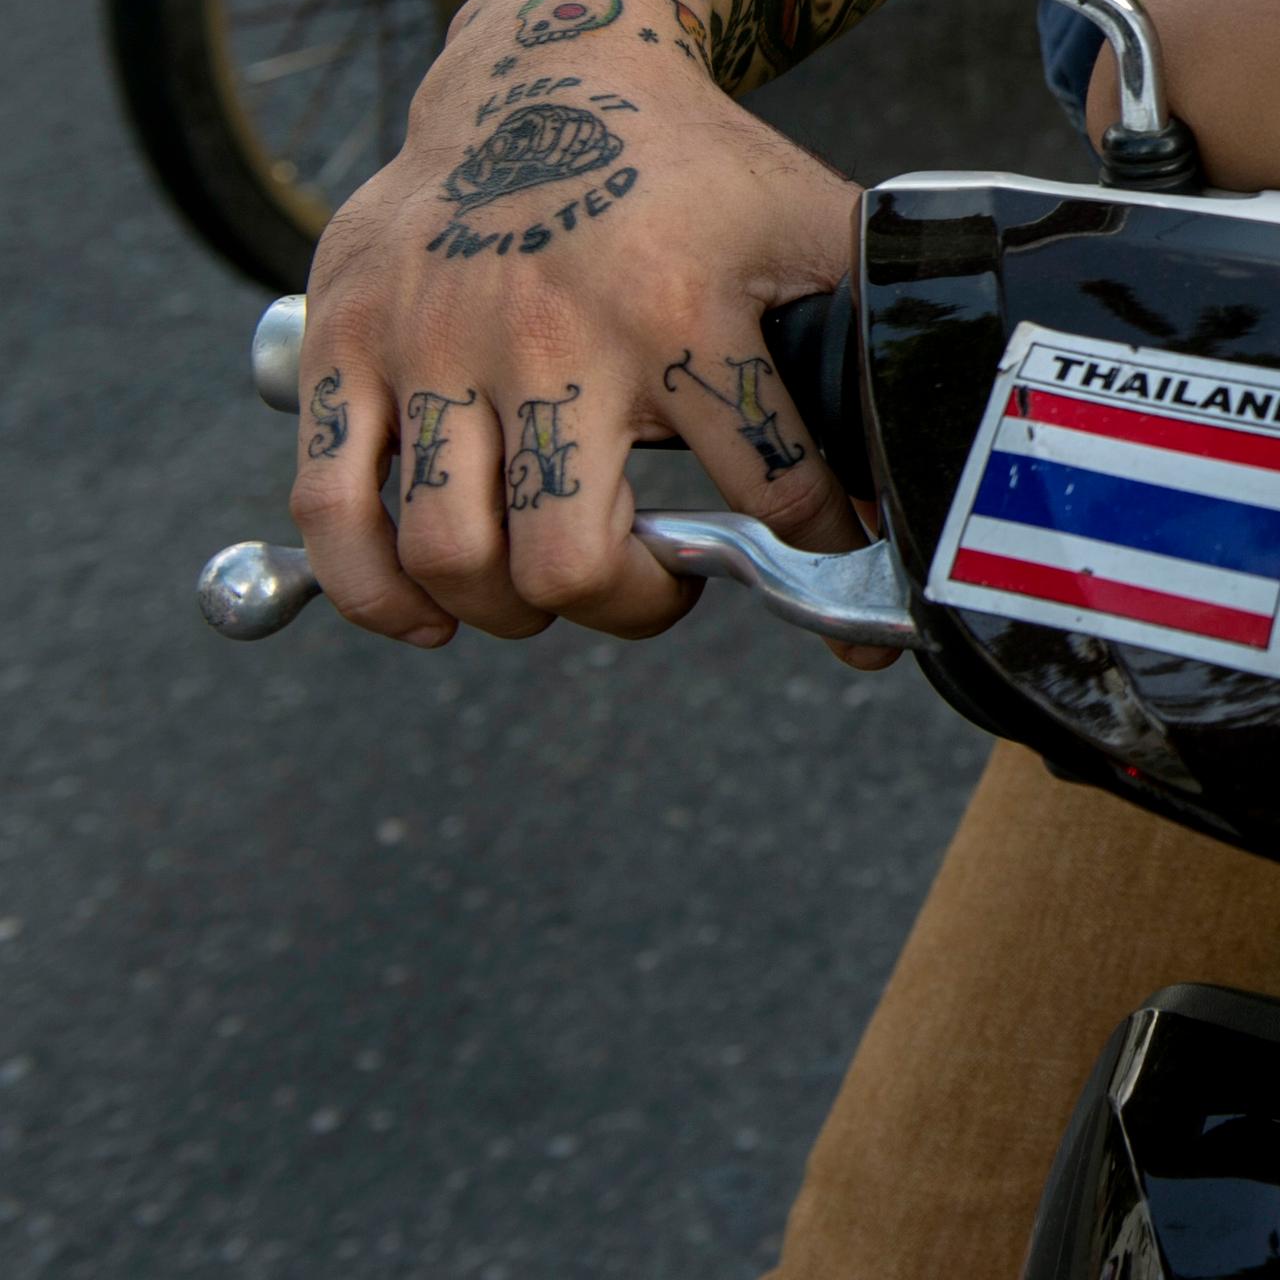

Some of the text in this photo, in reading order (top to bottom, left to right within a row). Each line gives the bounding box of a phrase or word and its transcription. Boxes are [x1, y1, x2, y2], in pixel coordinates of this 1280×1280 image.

[475, 76, 640, 127] KEEP IT
[424, 166, 640, 260] TWISTED
